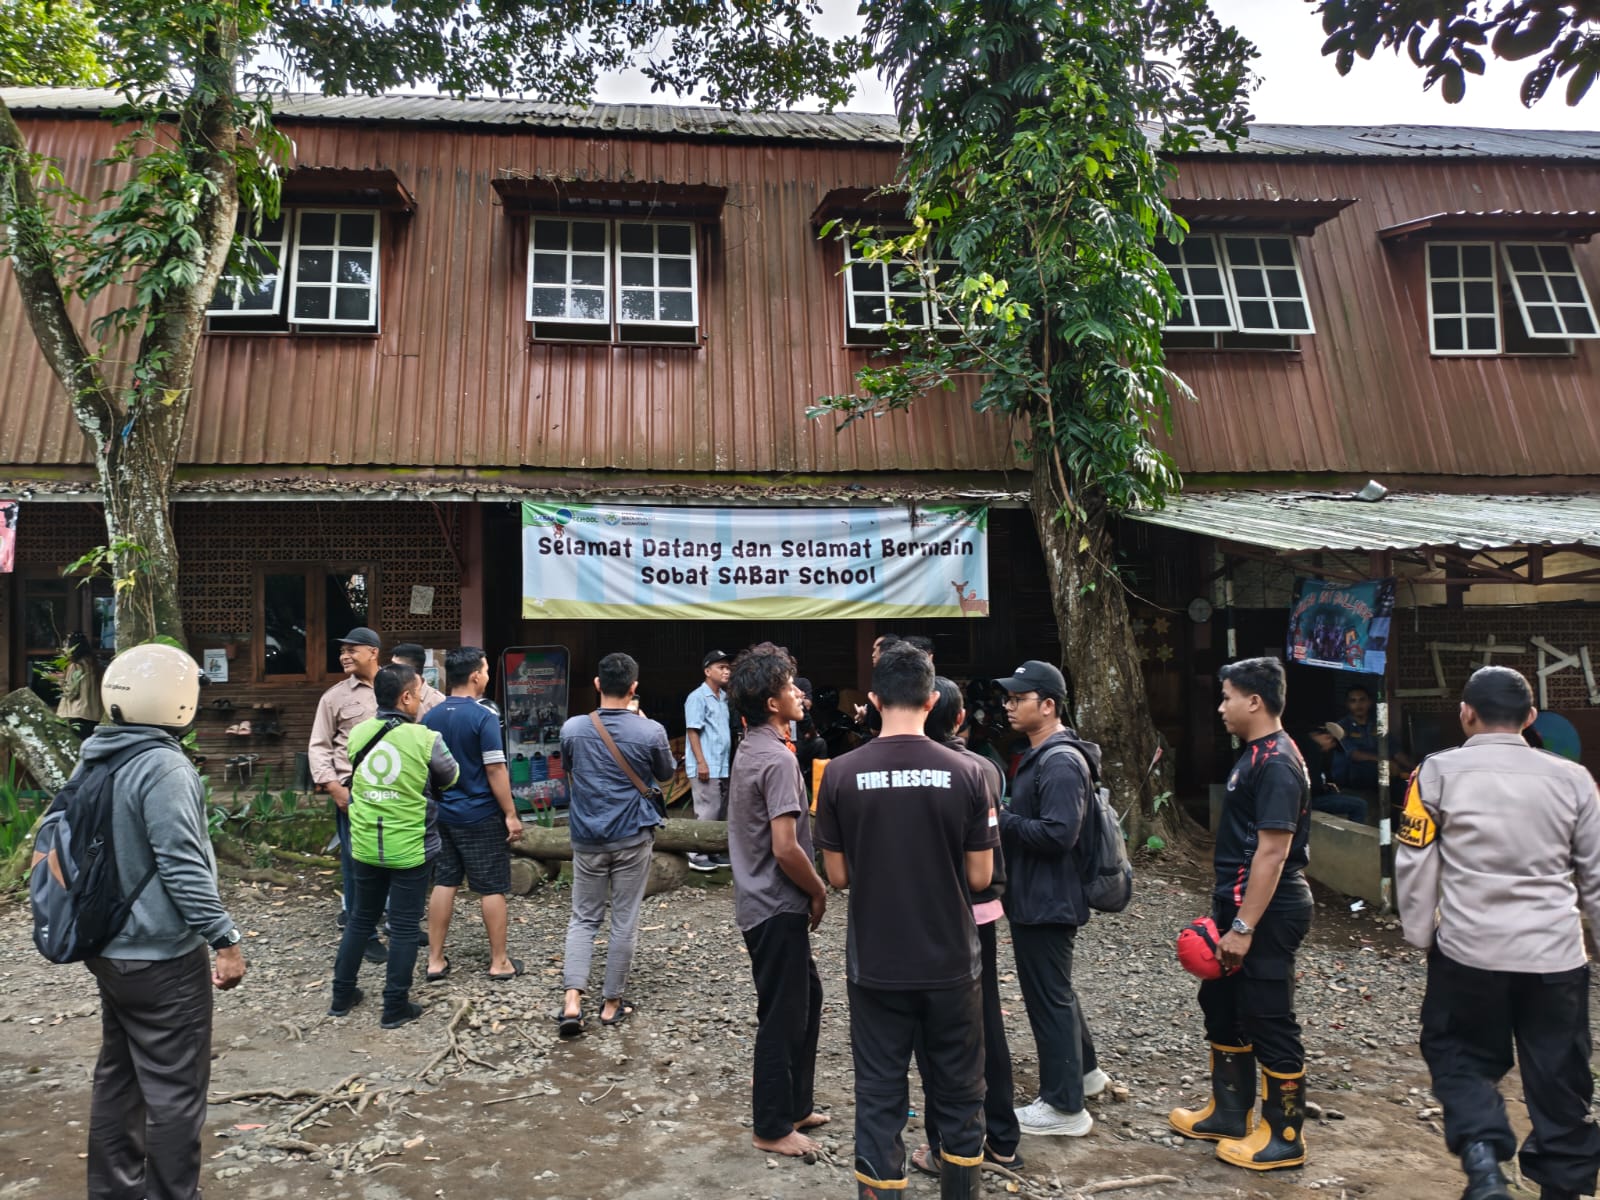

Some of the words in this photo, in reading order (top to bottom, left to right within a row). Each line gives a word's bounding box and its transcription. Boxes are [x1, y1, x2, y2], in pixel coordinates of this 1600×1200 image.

[537, 536, 633, 559] Selamat
[642, 538, 722, 562] Datang
[731, 538, 772, 559] dan
[781, 538, 872, 559] Selamat
[881, 537, 974, 559] Bermain
[641, 565, 709, 586] Sobat
[718, 565, 790, 586] SABar
[798, 565, 876, 586] School
[856, 771, 890, 790] FIRE
[891, 769, 951, 788] RESCUE
[362, 789, 401, 803] gojek
